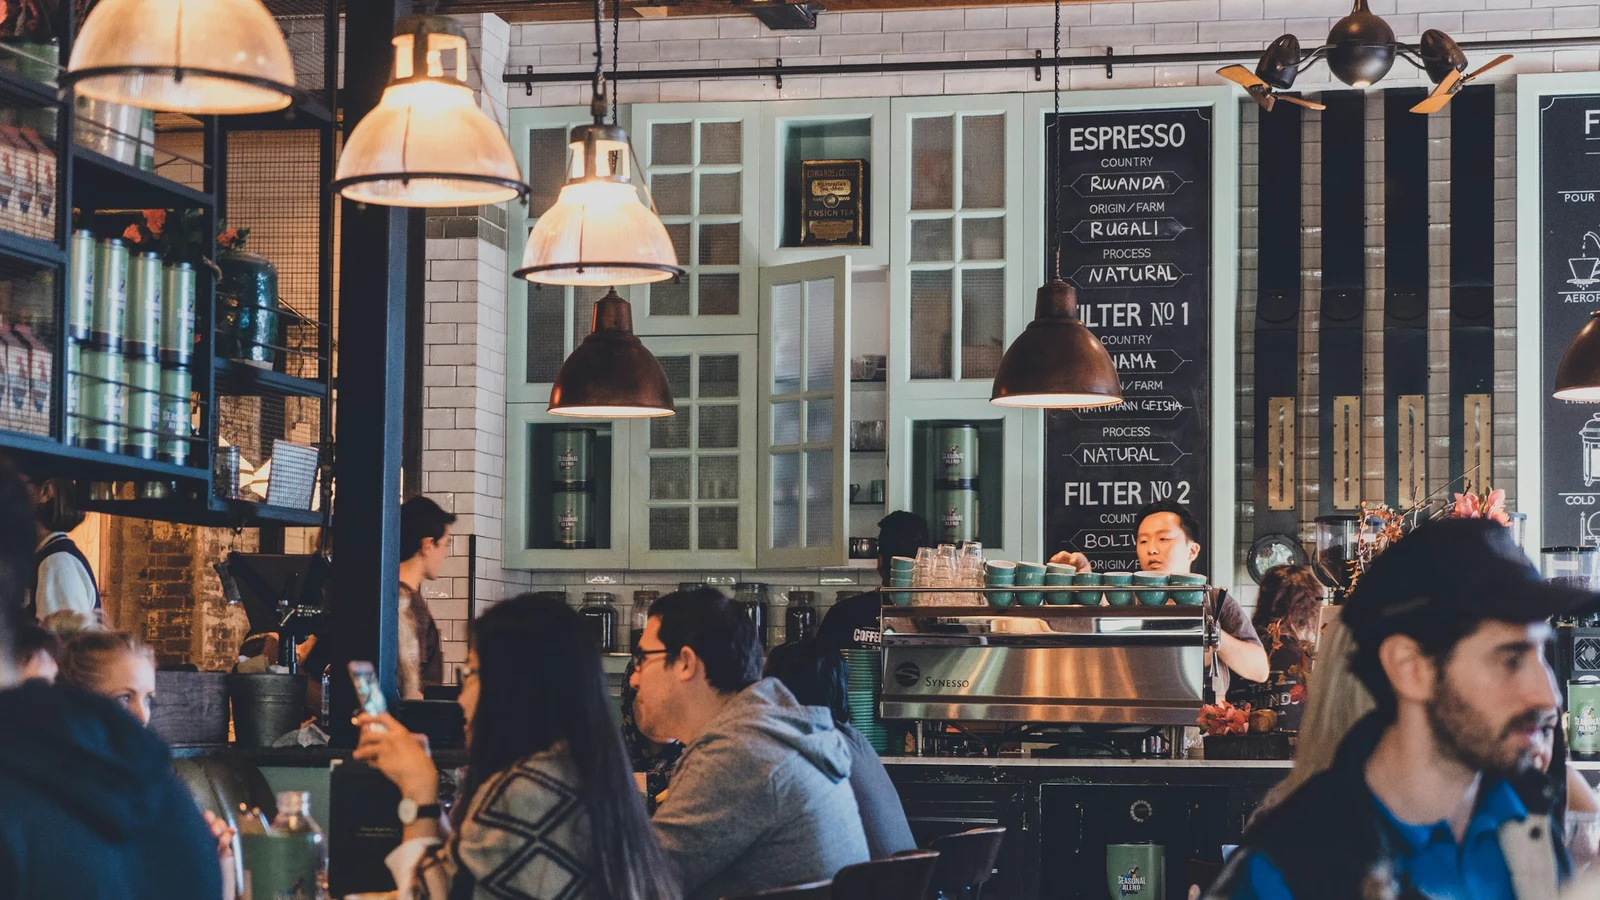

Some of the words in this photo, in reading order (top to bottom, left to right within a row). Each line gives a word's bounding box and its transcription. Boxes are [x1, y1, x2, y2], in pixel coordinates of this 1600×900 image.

[1070, 123, 1186, 151] ESPRESSO
[1101, 157, 1154, 168] COUNTRY
[1090, 175, 1165, 192] RWANDA
[1564, 193, 1595, 203] POUR
[808, 209, 838, 217] ENSIGN
[840, 208, 855, 217] TEA
[1089, 202, 1165, 214] ORIGIN/FARM
[1090, 220, 1159, 238] RUGALI
[1103, 248, 1151, 259] PROCESS
[1088, 265, 1178, 283] NATURAL
[1076, 302, 1143, 328] ILTER
[1181, 302, 1189, 326] 1
[1100, 334, 1153, 345] COUNTRY
[1141, 399, 1183, 411] GEISHA
[1102, 426, 1151, 437] PROCESS
[1083, 446, 1160, 463] NATURAL
[1064, 481, 1143, 506] FILTER
[1177, 480, 1190, 504] 2
[1565, 495, 1595, 505] COLD
[1100, 513, 1137, 524] COUNT
[1117, 875, 1146, 885] SEASONAL
